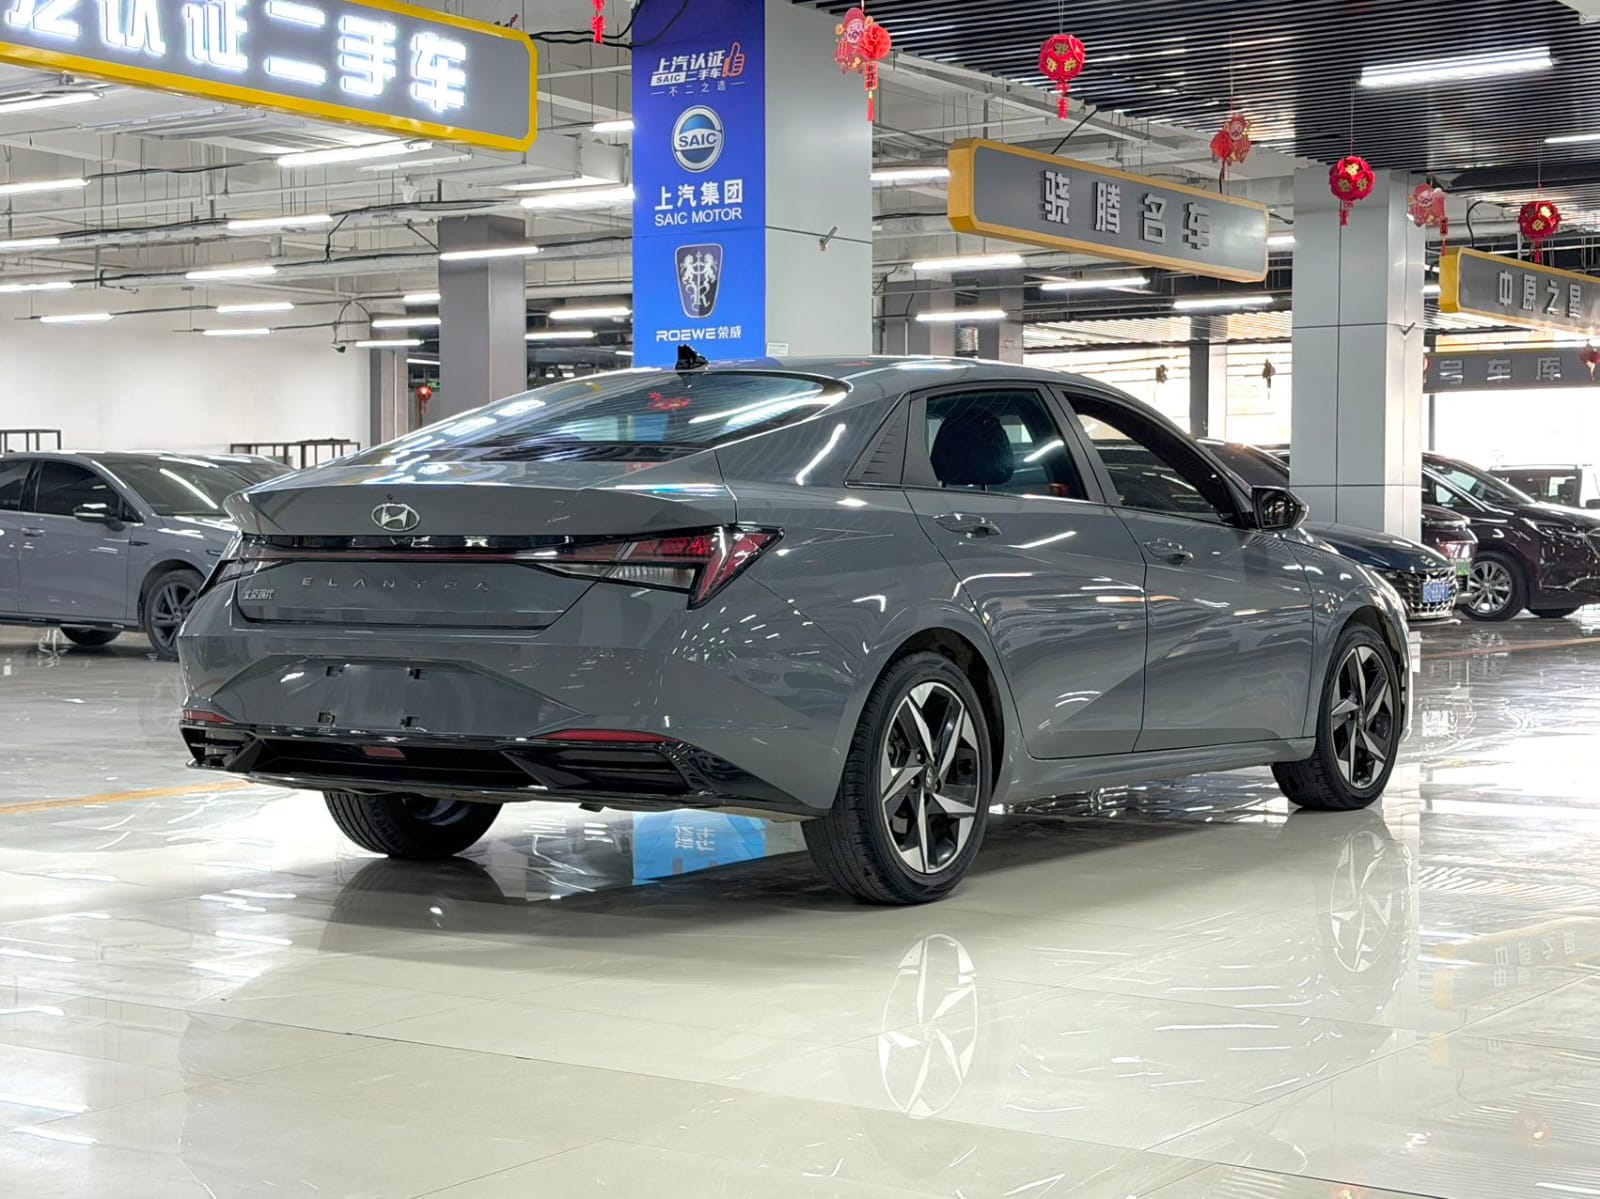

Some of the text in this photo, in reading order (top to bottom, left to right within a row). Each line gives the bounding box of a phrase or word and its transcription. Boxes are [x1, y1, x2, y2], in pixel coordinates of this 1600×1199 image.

[652, 50, 726, 75] 上汽认证
[656, 67, 722, 84] SAIC 二手车
[678, 131, 717, 149] SAIC
[654, 179, 743, 211] 上汽集团
[654, 207, 742, 227] SAIC MOTOR
[302, 576, 489, 592] ELANTRA
